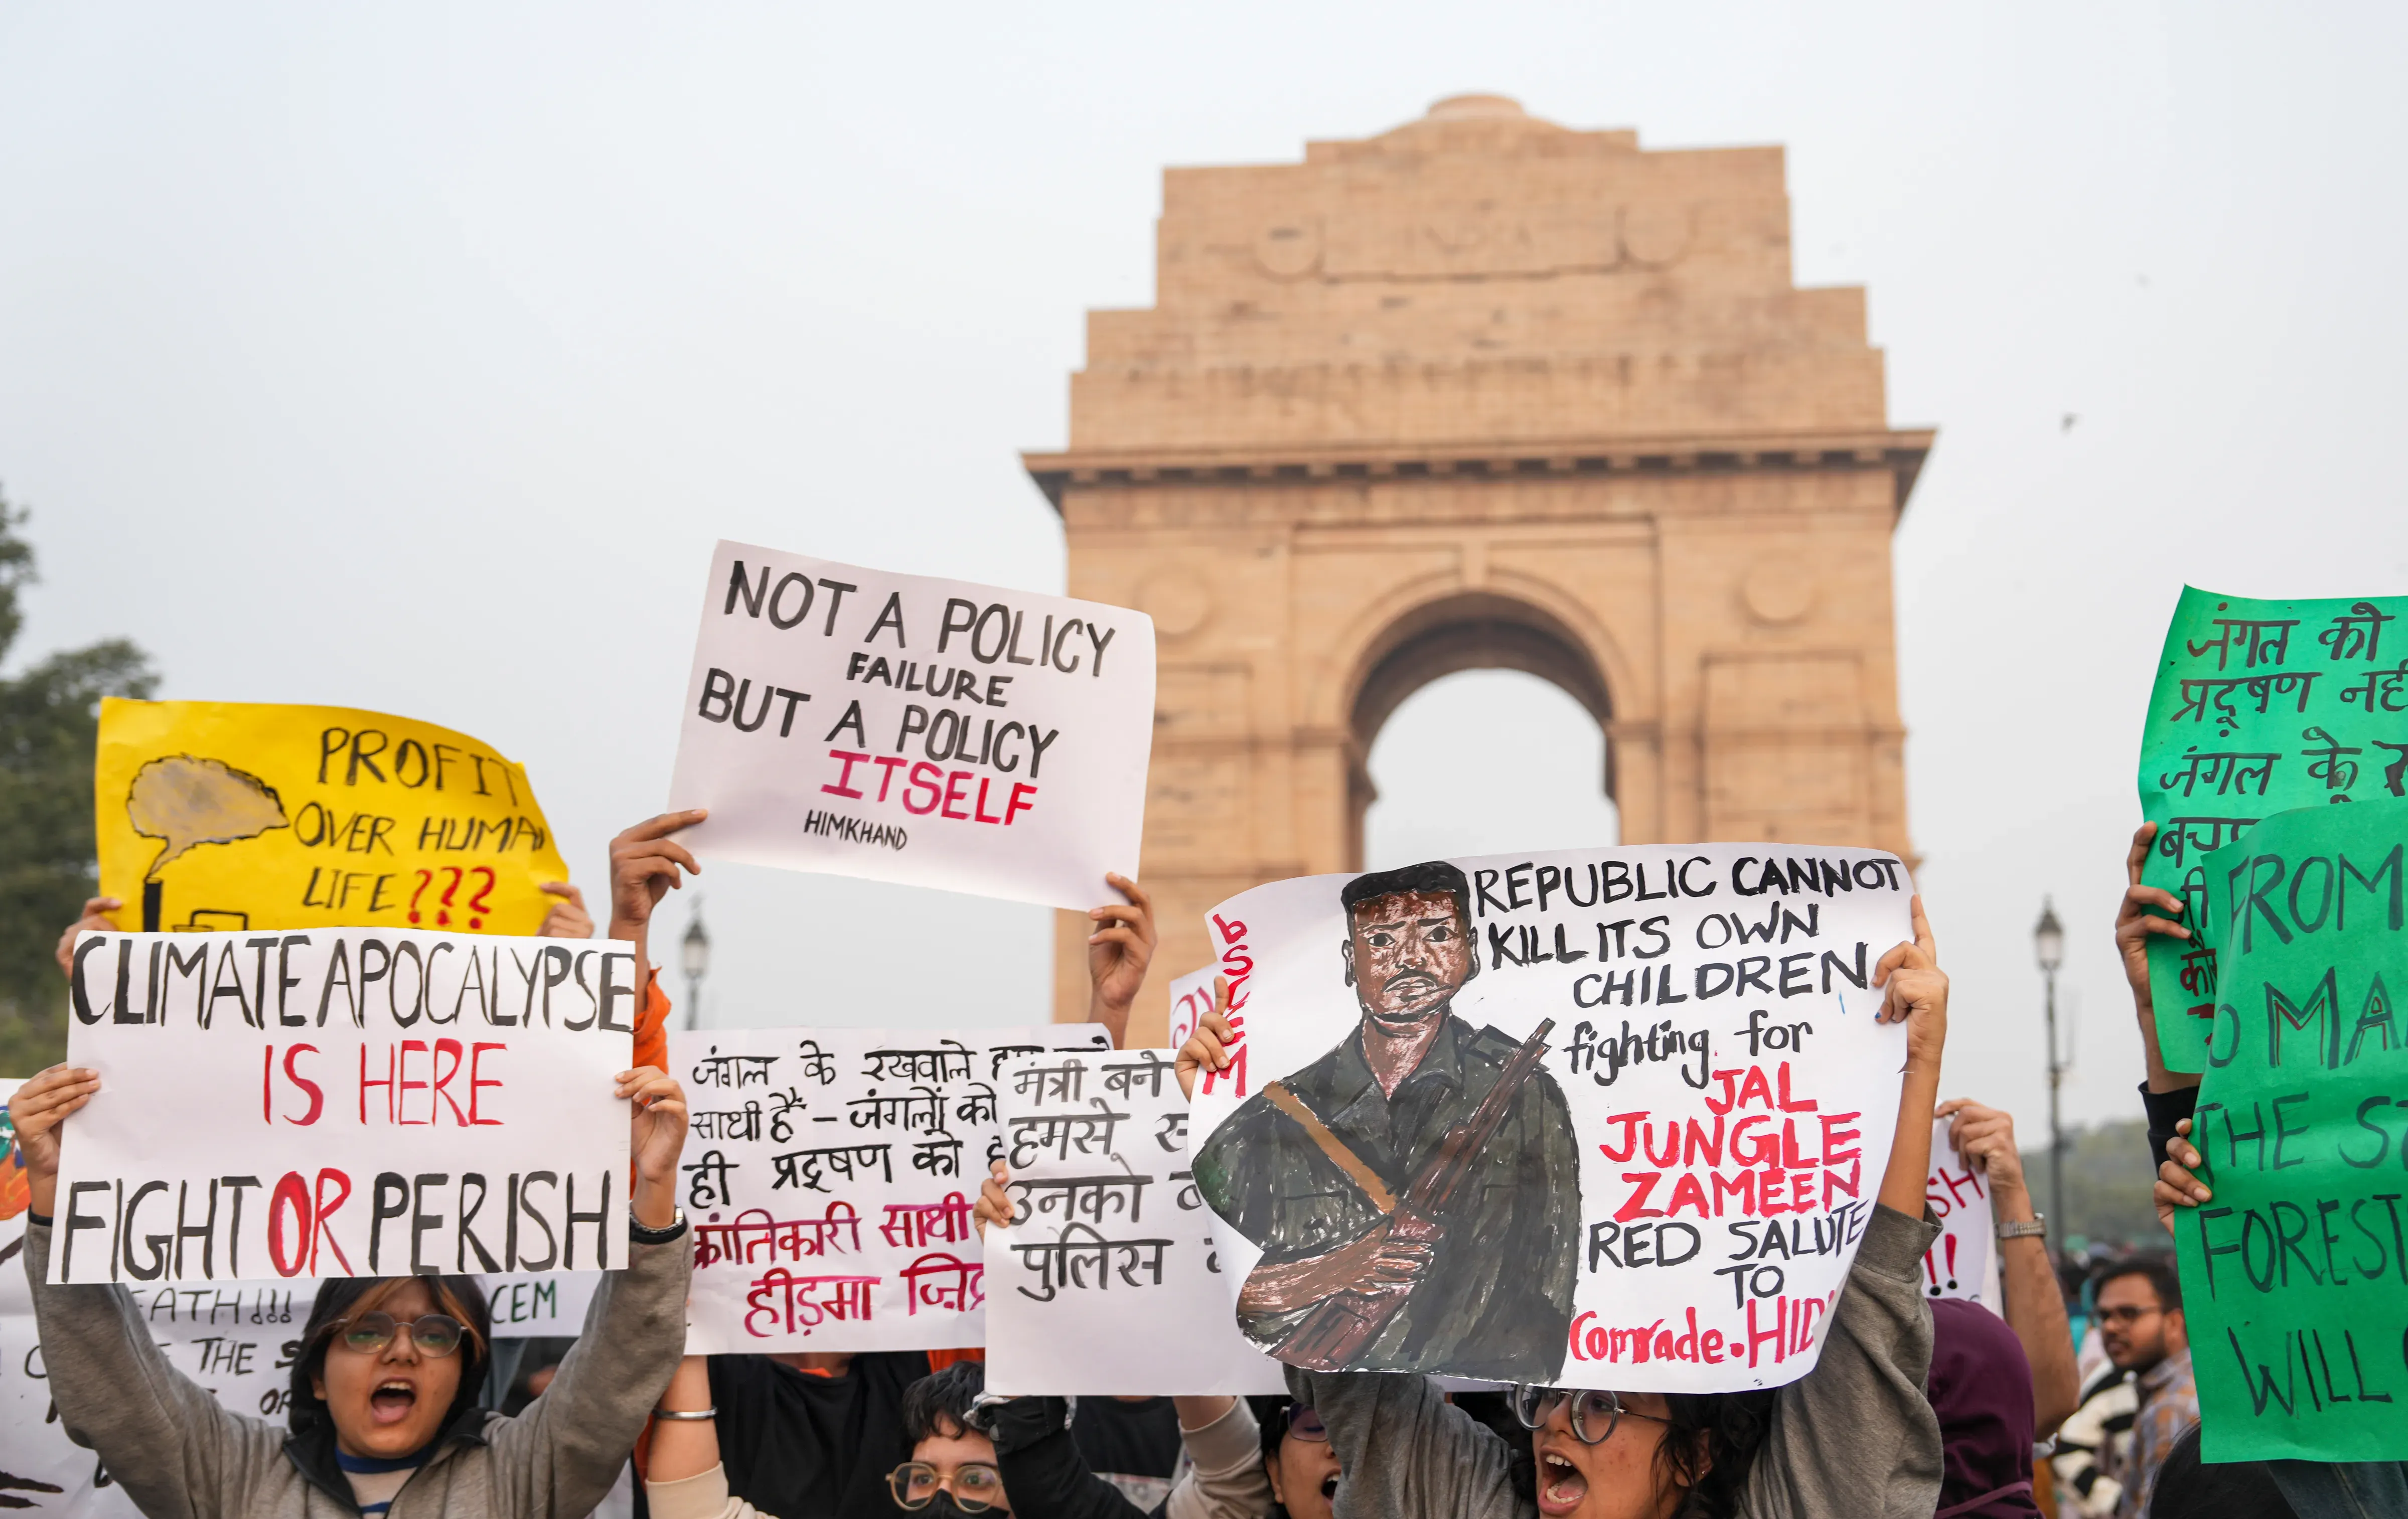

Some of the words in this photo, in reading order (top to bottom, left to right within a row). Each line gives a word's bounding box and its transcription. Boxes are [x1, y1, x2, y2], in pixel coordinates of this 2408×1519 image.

[724, 560, 857, 636] NOT
[864, 592, 906, 649] A
[937, 597, 1116, 677] POLICY
[2318, 601, 2396, 662] को
[846, 652, 1013, 707] FAILURE
[2170, 672, 2323, 729] प्रदूषण
[698, 668, 811, 737] BUT
[824, 700, 866, 748] A
[896, 704, 1059, 778] POLICY
[318, 726, 519, 807] PROFIT
[820, 749, 1038, 825] ITSELF
[2159, 745, 2282, 798] जंगल
[294, 802, 395, 855] OVER
[804, 809, 908, 851] HIMKHAND
[302, 867, 397, 912] LIFE
[1474, 856, 1716, 917] REPUBLIC
[1731, 856, 1900, 898] CANNOT
[2229, 843, 2403, 955] FROM
[1487, 922, 1587, 970] KILL
[1598, 915, 1671, 963] ITS
[1696, 901, 1820, 949] OWN
[71, 935, 312, 1029] CLIMATE
[317, 939, 636, 1032] APOCALYPSE
[1573, 942, 1869, 1009] CHILDREN
[1561, 1019, 1710, 1089] fighting
[1734, 1009, 1813, 1056] for
[2263, 966, 2408, 1070] MA
[264, 1042, 324, 1126] IS
[360, 1037, 508, 1127] HERE
[692, 1045, 781, 1089] जंगल
[800, 1040, 836, 1085] के
[861, 1039, 978, 1083] रखवाले
[1012, 1057, 1089, 1107] मंत्री
[1705, 1061, 1819, 1116] JAL
[690, 1101, 763, 1141] साथी
[1008, 1096, 1131, 1170] हमसे
[1599, 1111, 1862, 1170] JUNGLE
[2194, 1091, 2310, 1188] THE
[682, 1150, 740, 1209] ही
[912, 1129, 964, 1179] को
[1004, 1152, 1154, 1226] उनको
[1613, 1158, 1860, 1223] ZAMEEN
[61, 1175, 261, 1284] FIGHT
[267, 1167, 352, 1278] OR
[369, 1170, 610, 1275] PERISH
[1588, 1222, 1701, 1273] RED
[1728, 1199, 1870, 1261] SALUTE
[1010, 1221, 1175, 1302] पुलिस
[1713, 1263, 1784, 1310] TO
[191, 1336, 257, 1375] THE
[2227, 1326, 2393, 1419] WILL
